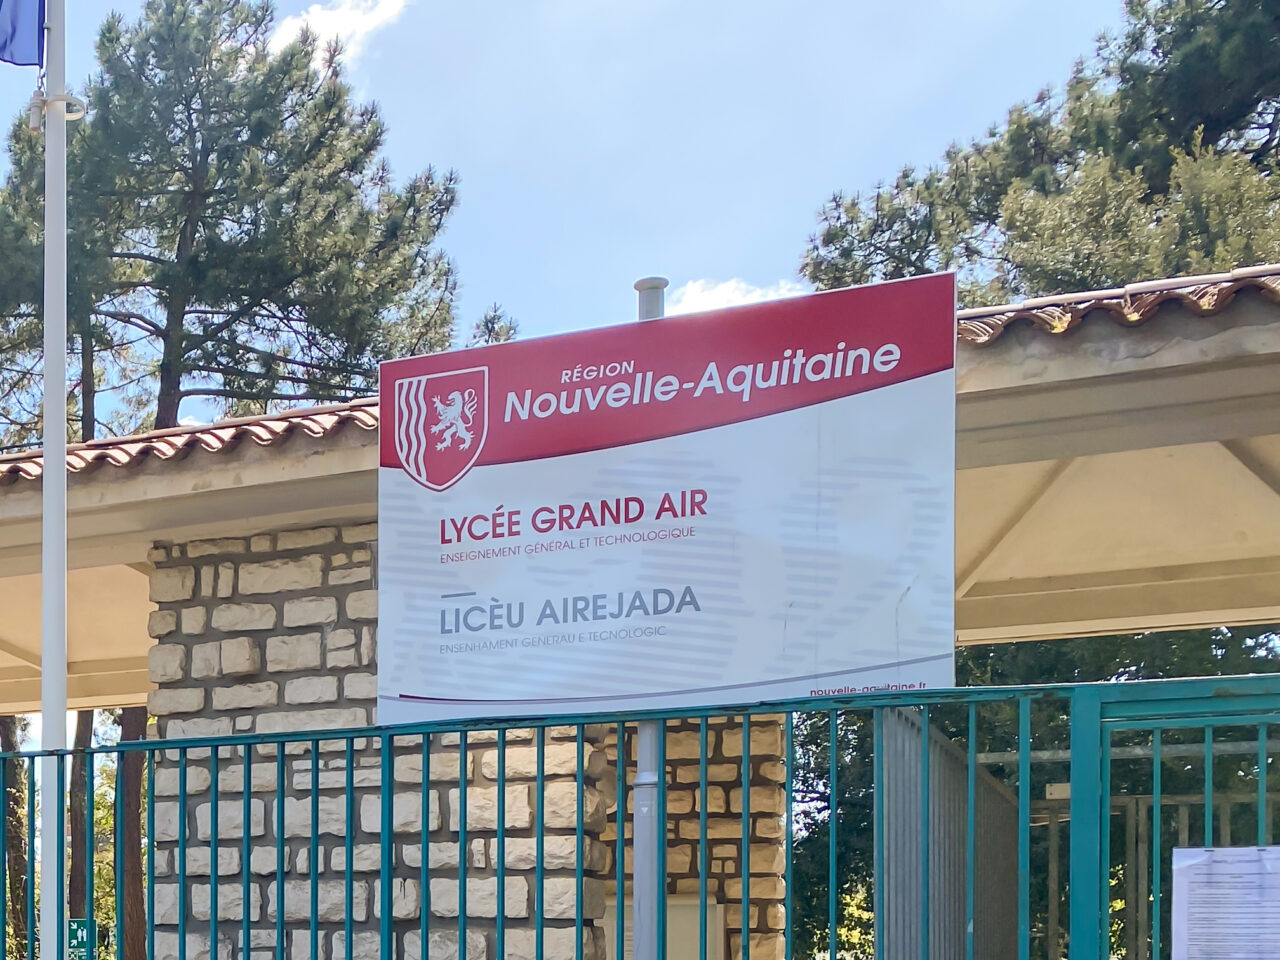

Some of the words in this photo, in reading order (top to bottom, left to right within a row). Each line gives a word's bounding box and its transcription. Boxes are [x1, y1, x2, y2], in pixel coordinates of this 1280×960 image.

[504, 341, 901, 422] Nouvelle-Aquitaine
[560, 360, 634, 383] RÉGION
[440, 504, 520, 544] LYCÉE
[531, 496, 644, 533] GRAND
[655, 489, 708, 520] AIR
[440, 545, 520, 563] ENSEIGNEMENT
[524, 539, 576, 554] GÉNÉRAL
[579, 537, 590, 548] ET
[594, 526, 696, 546] TECHNOLOGIQUE
[440, 597, 524, 634] LICÈU
[536, 586, 701, 626] AIREJADA
[439, 638, 519, 655] ENSENHAMENT
[521, 633, 575, 648] GENERAU
[578, 632, 585, 643] E
[588, 625, 668, 642] TECNOLOGIC
